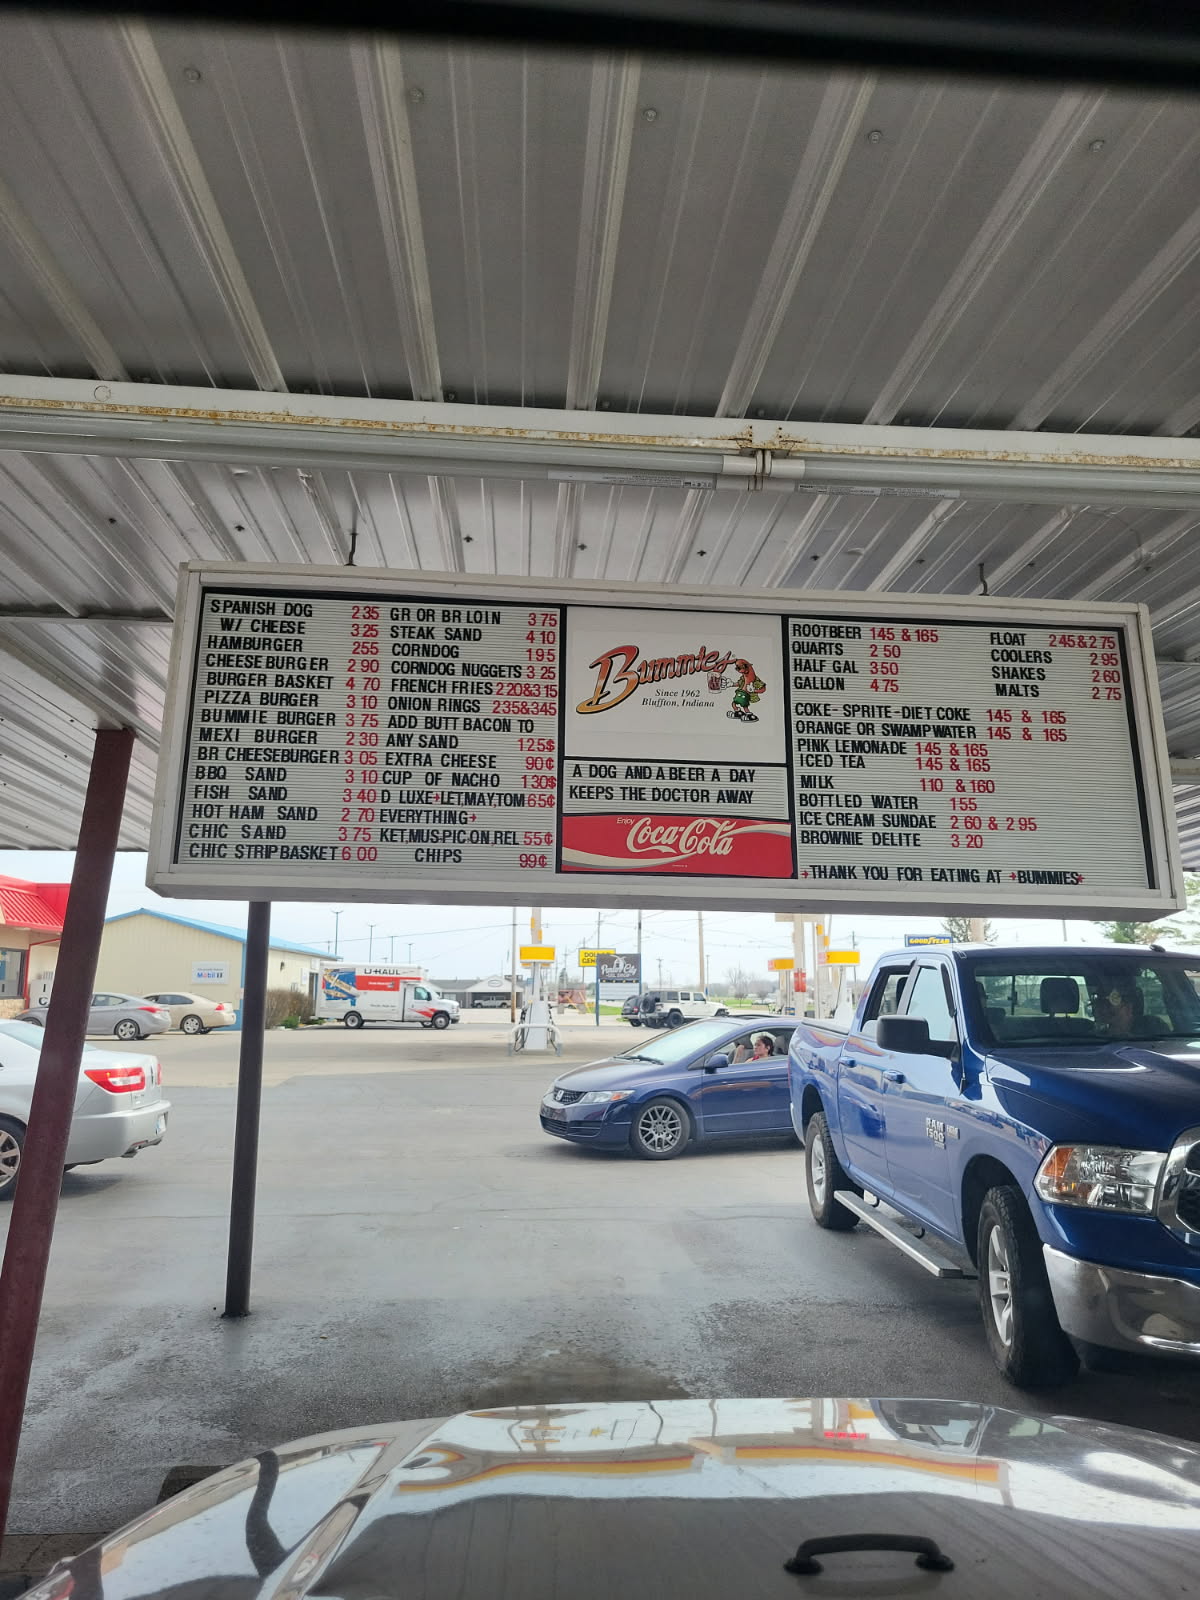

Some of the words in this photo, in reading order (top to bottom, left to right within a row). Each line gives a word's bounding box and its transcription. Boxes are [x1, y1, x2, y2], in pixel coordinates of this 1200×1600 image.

[210, 599, 276, 616] SPANISH
[284, 601, 313, 618] DOG
[390, 607, 412, 622] GR
[417, 608, 436, 622] OR
[441, 609, 462, 623] BR
[466, 610, 500, 624] LOIN
[221, 618, 242, 632] W/
[250, 619, 306, 635] CHEESE
[390, 625, 435, 639] STEAK
[444, 627, 482, 641] SAND
[792, 624, 862, 640] ROOTBEER
[869, 627, 895, 641] 145
[901, 628, 911, 641] &
[914, 629, 939, 643] 165
[207, 636, 303, 653] HAMBURGER
[352, 641, 379, 656] 255
[990, 632, 1027, 646] FLOAT
[391, 644, 459, 659] CORNDOG
[525, 648, 556, 662] 195
[792, 642, 843, 656] QUARTS
[991, 650, 1053, 664] COOLERS
[391, 661, 455, 676] CORNDOG
[461, 663, 522, 678] NUGGETS
[793, 660, 827, 673] HALF
[832, 661, 859, 674] GAL
[992, 666, 1046, 681] SHAKES
[206, 672, 267, 688] BURGER
[274, 675, 334, 690] BASKET
[391, 679, 446, 694] FRENCH
[451, 681, 493, 695] FRIES
[794, 677, 845, 691] GALLON
[204, 690, 252, 705] PIZZA
[260, 693, 319, 707] BURGER
[655, 689, 678, 697] Since
[680, 689, 700, 698] 1962
[995, 684, 1039, 697] MALTS
[387, 697, 432, 711] ONION
[437, 698, 481, 713] RINGS
[681, 699, 715, 708] Indiana
[200, 709, 268, 724] BUMMIE
[277, 711, 336, 727] BURGER
[387, 715, 418, 729] ADD
[424, 716, 459, 731] BUTT
[463, 718, 511, 733] BACON
[517, 719, 534, 733] TO
[936, 707, 971, 721] COKE
[986, 709, 1012, 723] 145
[1021, 710, 1032, 723] &
[1041, 711, 1066, 724] 165
[199, 728, 240, 742] MEXI
[254, 729, 318, 745] BURGER
[795, 720, 851, 735] ORANGE
[857, 722, 875, 736] OR
[986, 727, 1012, 741] 145
[1022, 728, 1032, 741] &
[1042, 728, 1067, 742] 165
[386, 734, 415, 748] ANY
[418, 735, 459, 749] SAND
[797, 739, 830, 753] PINK
[835, 740, 908, 755] LEMONADE
[915, 742, 941, 756] 145
[949, 744, 960, 756] &
[963, 744, 988, 757] 165
[197, 747, 219, 761] BR
[225, 747, 339, 764] CHEESEBURGER
[385, 752, 433, 767] EXTRA
[440, 753, 497, 769] CHEESE
[800, 755, 833, 768] ICED
[840, 756, 866, 769] TEA
[915, 757, 942, 771] 145
[950, 758, 961, 771] &
[966, 758, 991, 772] 165
[195, 766, 227, 780] BBQ
[245, 767, 287, 782] SAND
[382, 771, 412, 785] CUP
[425, 772, 442, 786] OF
[451, 773, 500, 788] NACHO
[572, 764, 582, 777] A
[589, 765, 617, 778] DOG
[624, 766, 652, 779] AND
[655, 767, 665, 780] A
[668, 767, 705, 781] BEER
[711, 768, 720, 781] A
[729, 768, 756, 782] DAY
[800, 775, 835, 790] MILK
[919, 778, 943, 792] 110
[955, 779, 966, 792] &
[970, 780, 995, 793] 160
[194, 785, 229, 799] FISH
[248, 786, 288, 801] SAND
[569, 785, 614, 800] KEEPS
[619, 786, 646, 801] THE
[651, 787, 710, 803] DOCTOR
[716, 790, 754, 804] AWAY
[799, 794, 862, 808] BOTTLED
[871, 796, 918, 810] WATER
[950, 797, 977, 812] 155
[192, 805, 224, 819] HOT
[229, 806, 265, 820] HAM
[277, 806, 318, 821] SAND
[379, 809, 468, 825] EVERYTHING
[799, 812, 822, 826] ICE
[826, 813, 875, 828] CREAM
[882, 815, 937, 829] SUNDAE
[988, 817, 999, 831] &
[189, 824, 229, 839] CHIC
[241, 825, 287, 840] SAND
[616, 817, 635, 825] Enjoy
[626, 817, 737, 855] Coca-Cola
[801, 831, 863, 846] BROWNIE
[872, 833, 921, 847] DELITE
[189, 843, 227, 859] CHIC
[415, 848, 462, 863] CHIPS
[809, 865, 857, 880] THANK
[862, 866, 888, 880] YOU
[897, 867, 923, 881] FOR
[931, 868, 980, 883] EATING
[986, 869, 1002, 883] AT
[1017, 870, 1080, 885] BUMMIES
[909, 936, 950, 945] GOODYEAR
[925, 1117, 945, 1133] RAM
